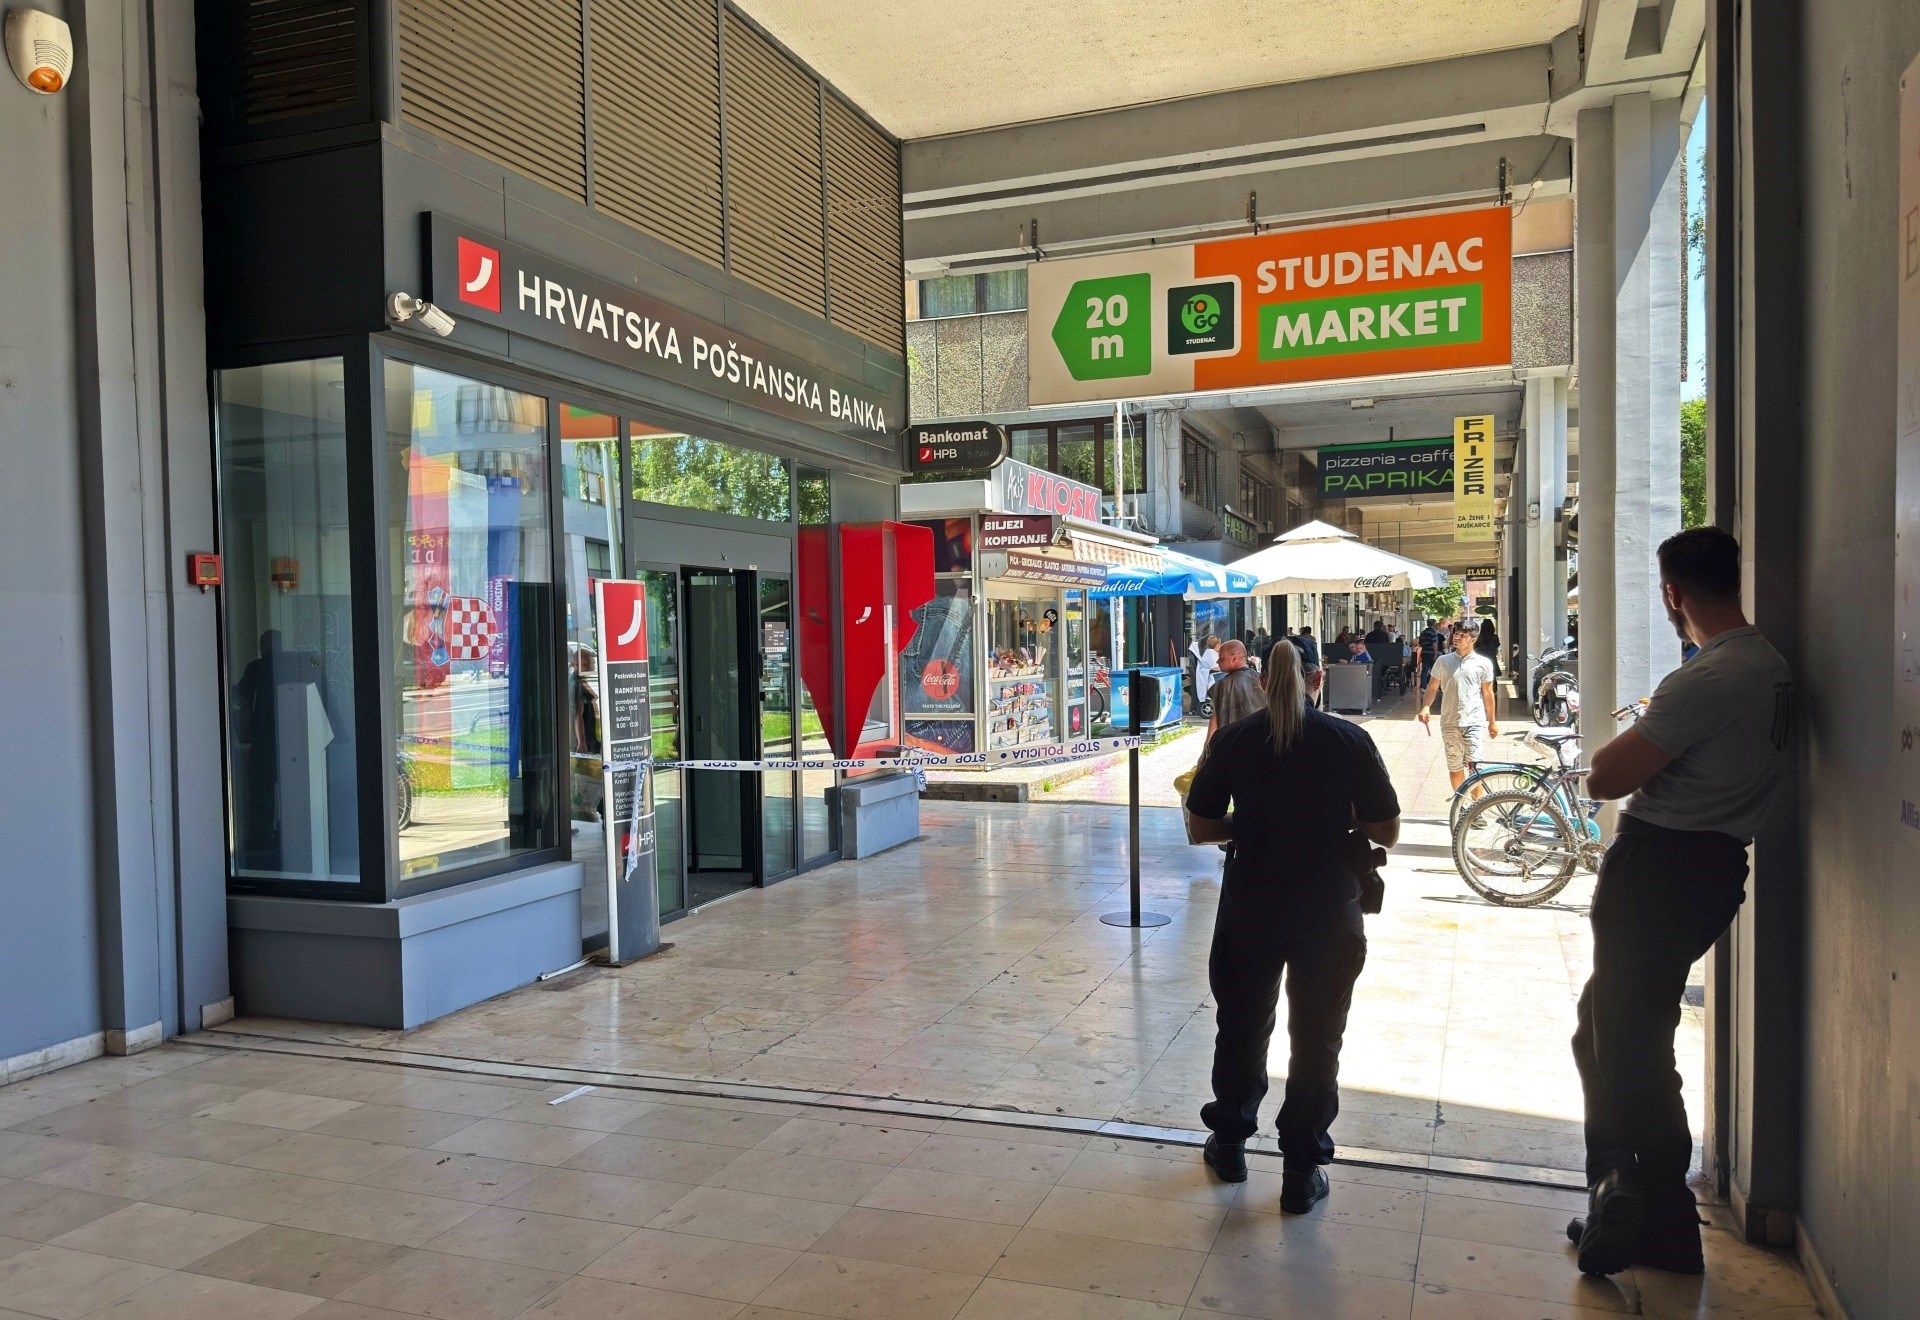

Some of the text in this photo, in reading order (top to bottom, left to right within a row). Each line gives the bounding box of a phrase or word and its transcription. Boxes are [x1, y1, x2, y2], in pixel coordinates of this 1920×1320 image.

[1256, 237, 1483, 294] STUDENAC
[1086, 294, 1129, 329] 20
[1186, 298, 1208, 315] TO
[1193, 313, 1220, 331] GO
[1272, 297, 1467, 350] MARKET
[1091, 333, 1125, 361] m
[1185, 336, 1216, 345] STUDENAC
[517, 269, 886, 434] HRVATSKA POŠTANSKA BANKA
[919, 427, 988, 444] Bankomat
[933, 448, 957, 460] HPB
[1326, 453, 1396, 471] pizzeria
[1463, 418, 1484, 495] FRIZER
[1324, 468, 1455, 493] PAPRIKA
[1028, 470, 1099, 523] KIOSK
[984, 519, 1024, 531] BILJEZI
[1456, 521, 1491, 529] MUŠKARCE
[984, 533, 1048, 546] KOPIRANJE
[1466, 568, 1496, 576] ZLATAR
[1012, 745, 1064, 759] POLICIJA
[1070, 742, 1100, 753] STOP
[832, 760, 865, 768] STOP
[891, 754, 987, 766] STOP POLICIJA
